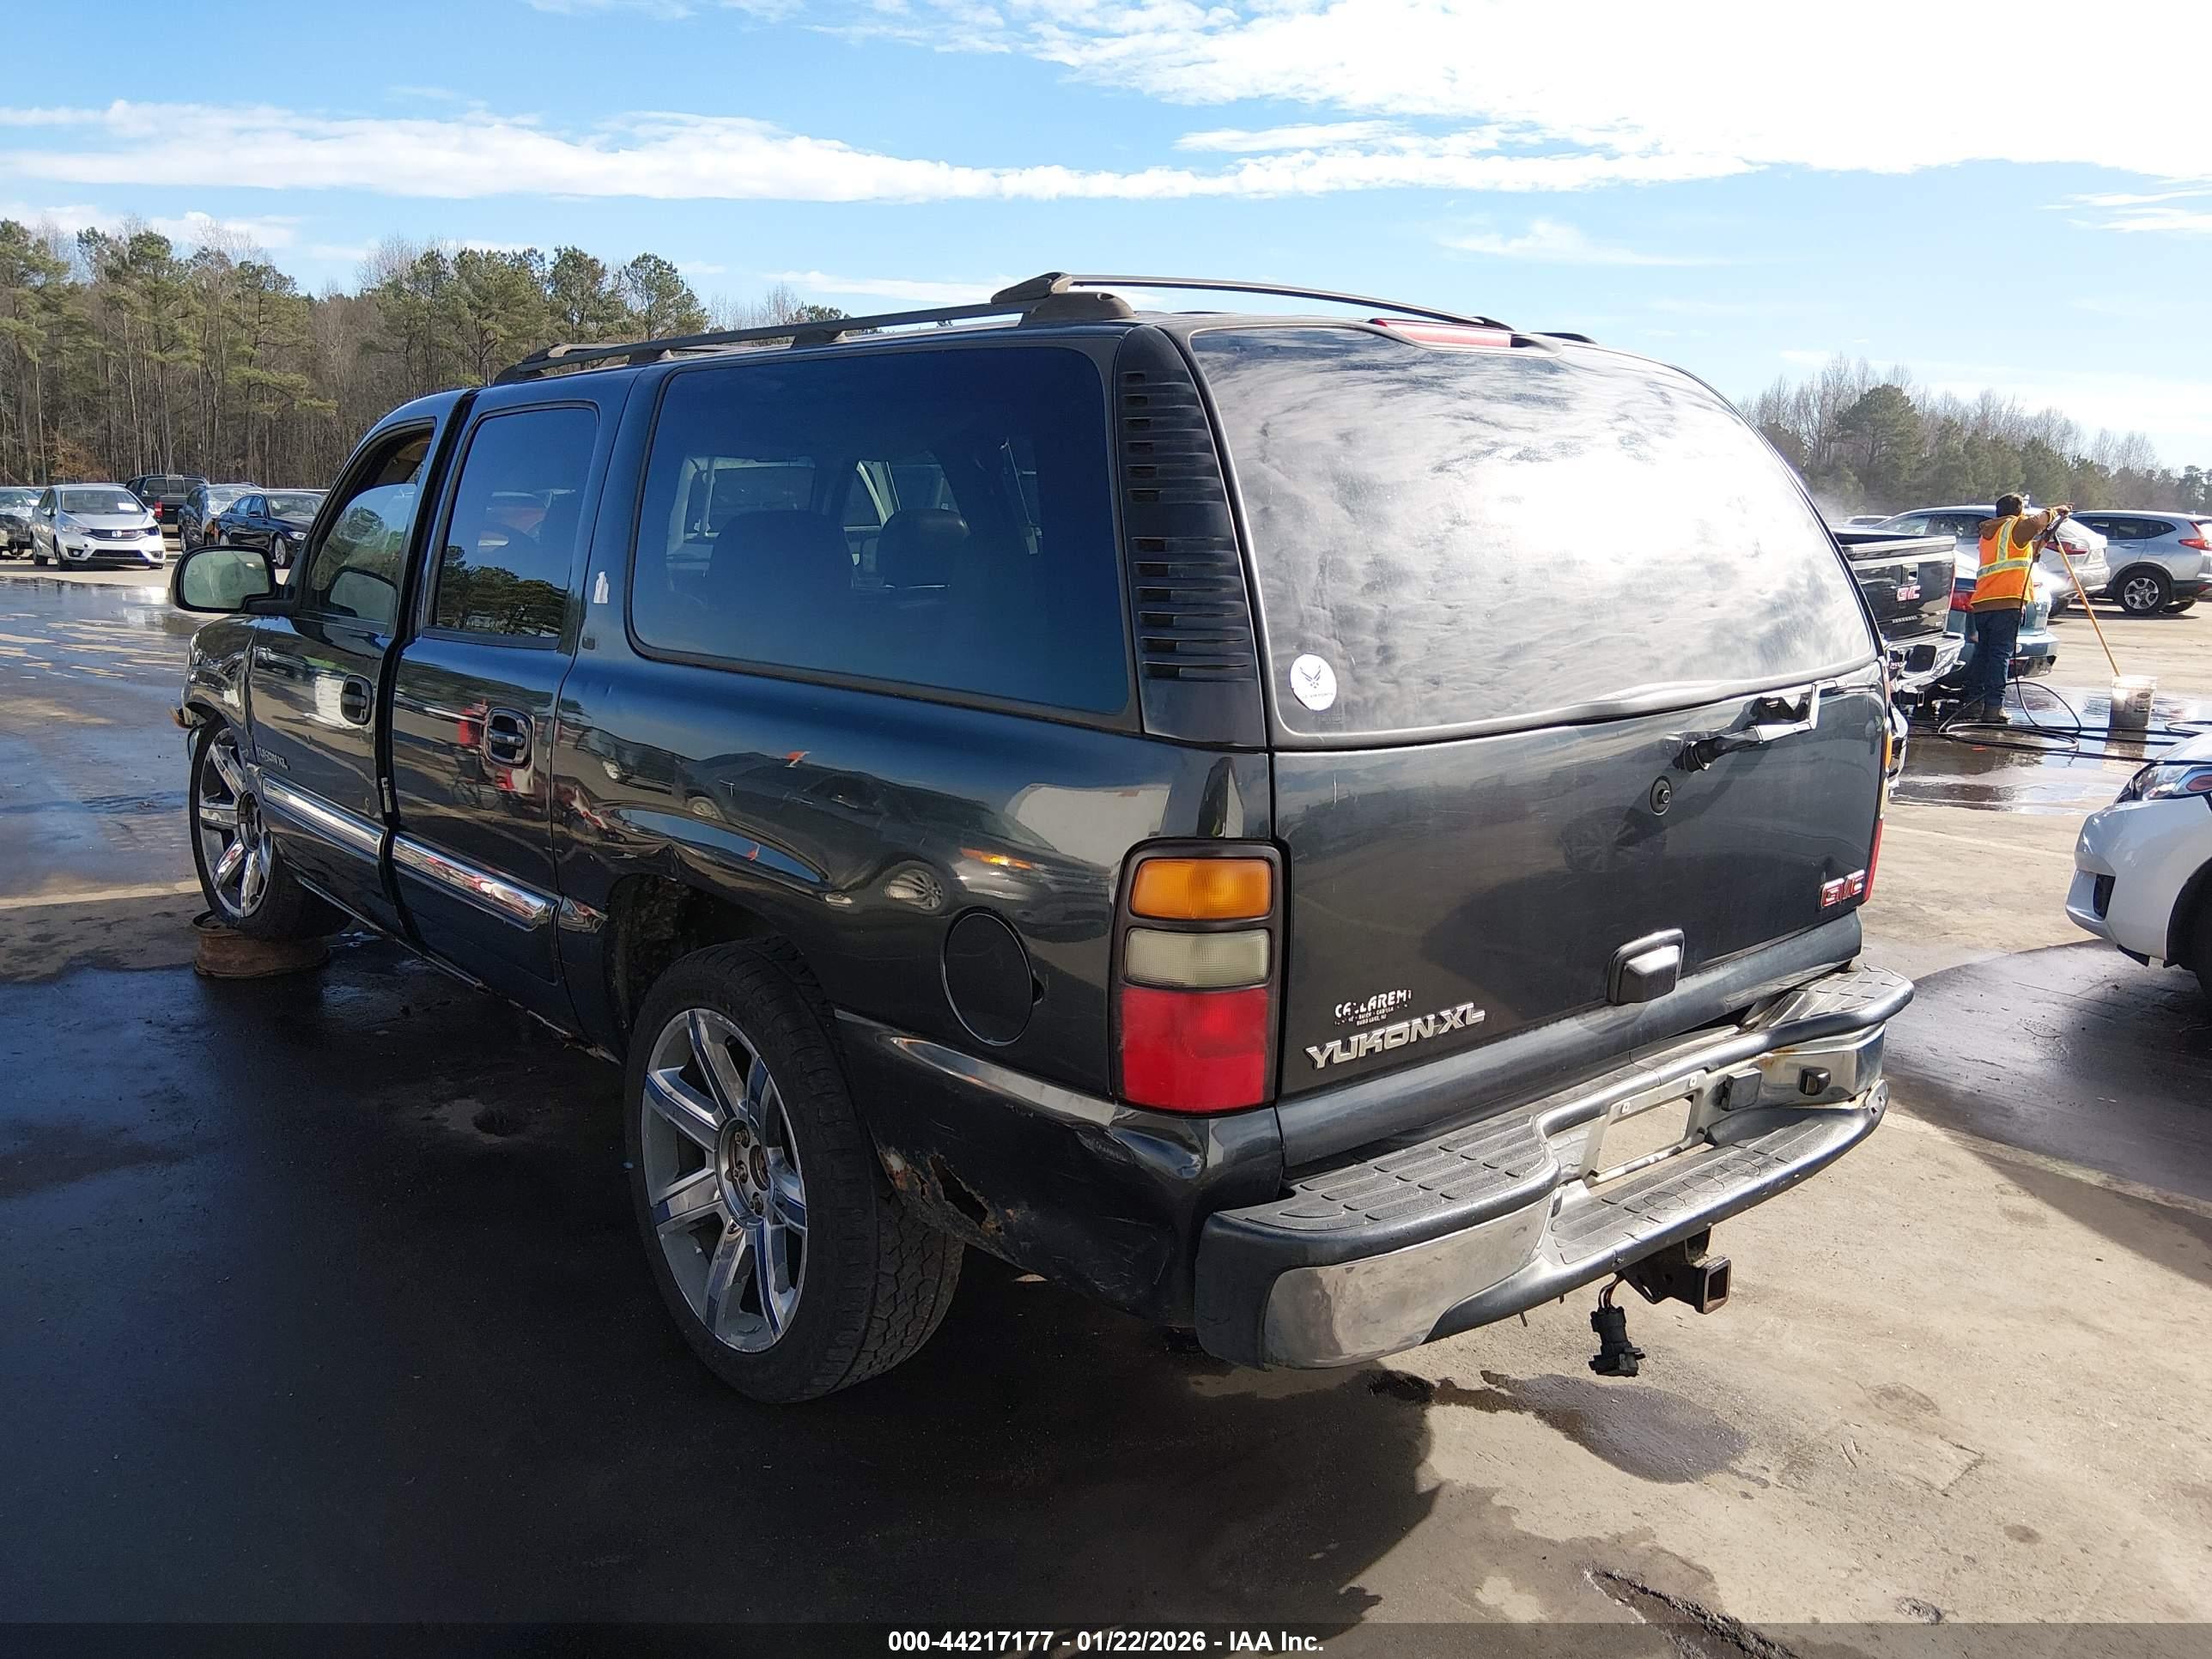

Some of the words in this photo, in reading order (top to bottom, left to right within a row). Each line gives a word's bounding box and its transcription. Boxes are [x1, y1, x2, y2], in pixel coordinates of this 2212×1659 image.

[1821, 870, 1864, 908] GMC
[1306, 1015, 1435, 1068] YUKON
[1437, 1003, 1486, 1034] XL
